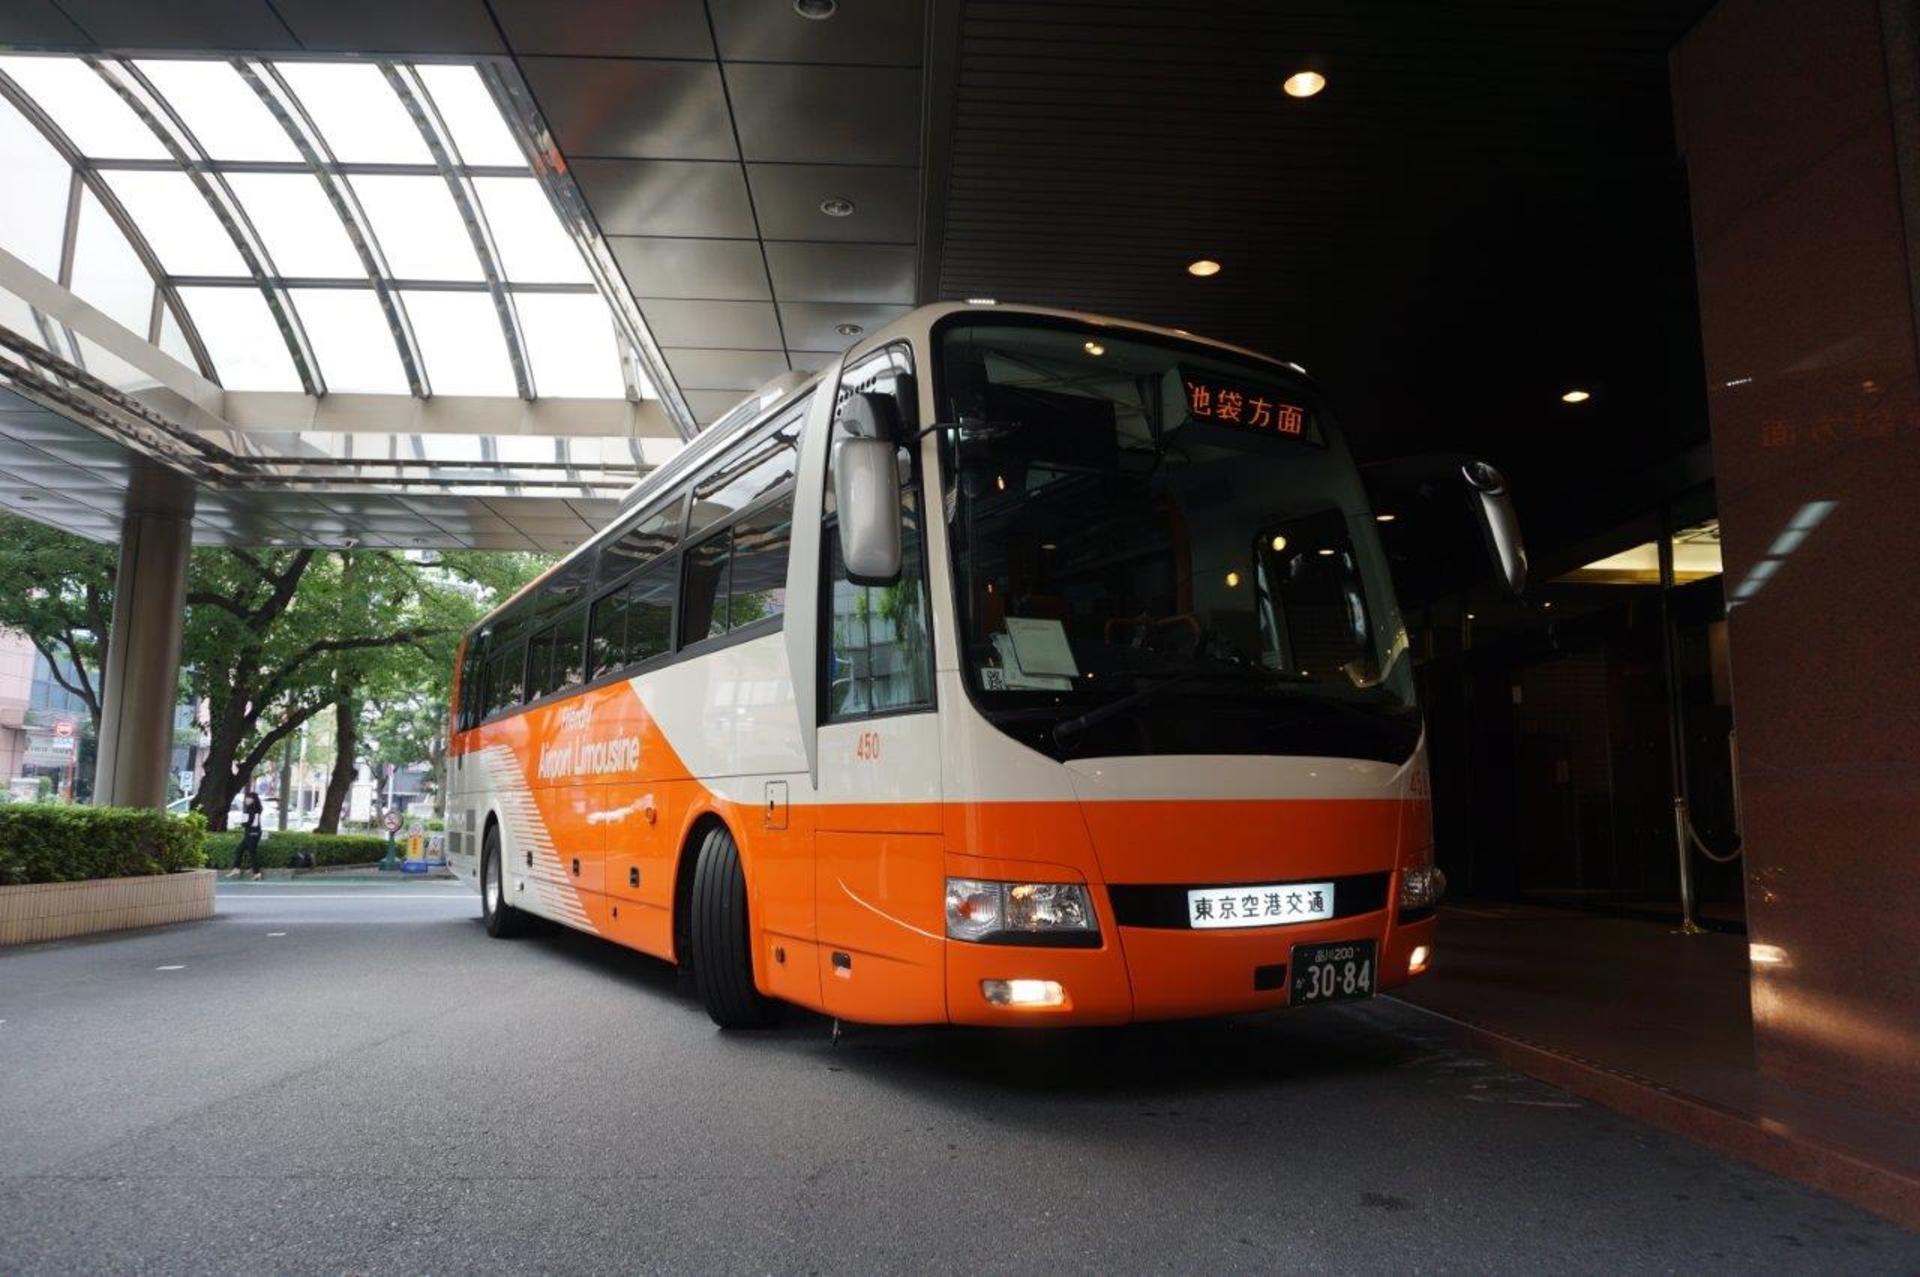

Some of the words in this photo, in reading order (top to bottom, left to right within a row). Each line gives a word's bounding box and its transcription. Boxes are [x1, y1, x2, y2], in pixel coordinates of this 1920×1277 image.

[1188, 381, 1304, 434] 池袋方面
[574, 729, 640, 775] Limousine
[857, 732, 880, 760] 450
[1194, 889, 1326, 921] 東京空港交通
